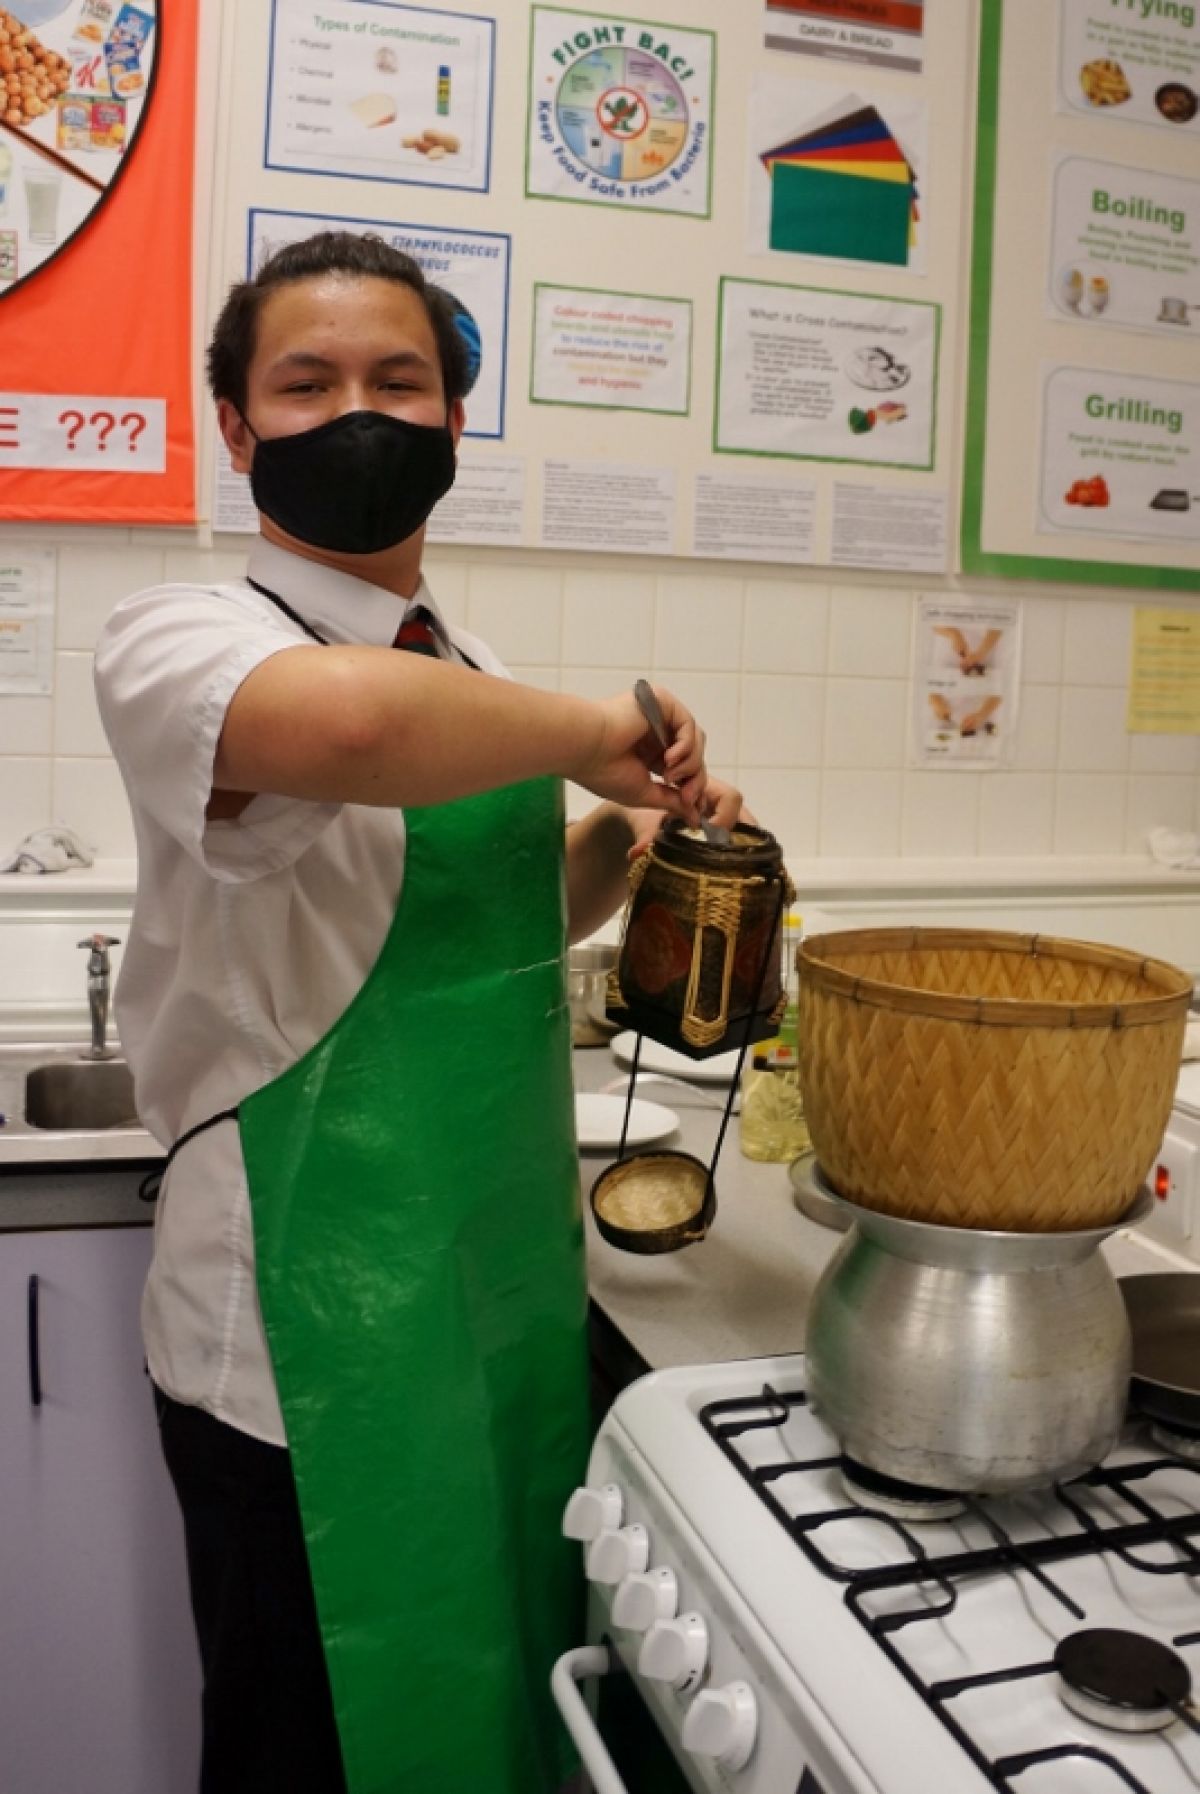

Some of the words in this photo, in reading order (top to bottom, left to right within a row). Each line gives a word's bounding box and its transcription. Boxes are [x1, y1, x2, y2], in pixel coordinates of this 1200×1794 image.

[313, 15, 349, 32] Types
[354, 22, 368, 33] of
[370, 24, 461, 46] Contamination
[552, 26, 625, 66] FIGHT
[850, 32, 893, 49] BREAD
[552, 146, 588, 183] Food
[589, 178, 625, 198] Safe
[670, 121, 707, 181] Bacteria
[1091, 189, 1185, 233] Boiling
[553, 305, 590, 318] Colour
[748, 308, 779, 321] What
[783, 312, 793, 322] is
[795, 313, 825, 327] Cross
[574, 334, 611, 346] reduce
[612, 337, 629, 348] the
[553, 346, 626, 361] contamination
[647, 354, 667, 368] they
[1085, 393, 1184, 434] Grilling
[58, 409, 147, 452] ???
